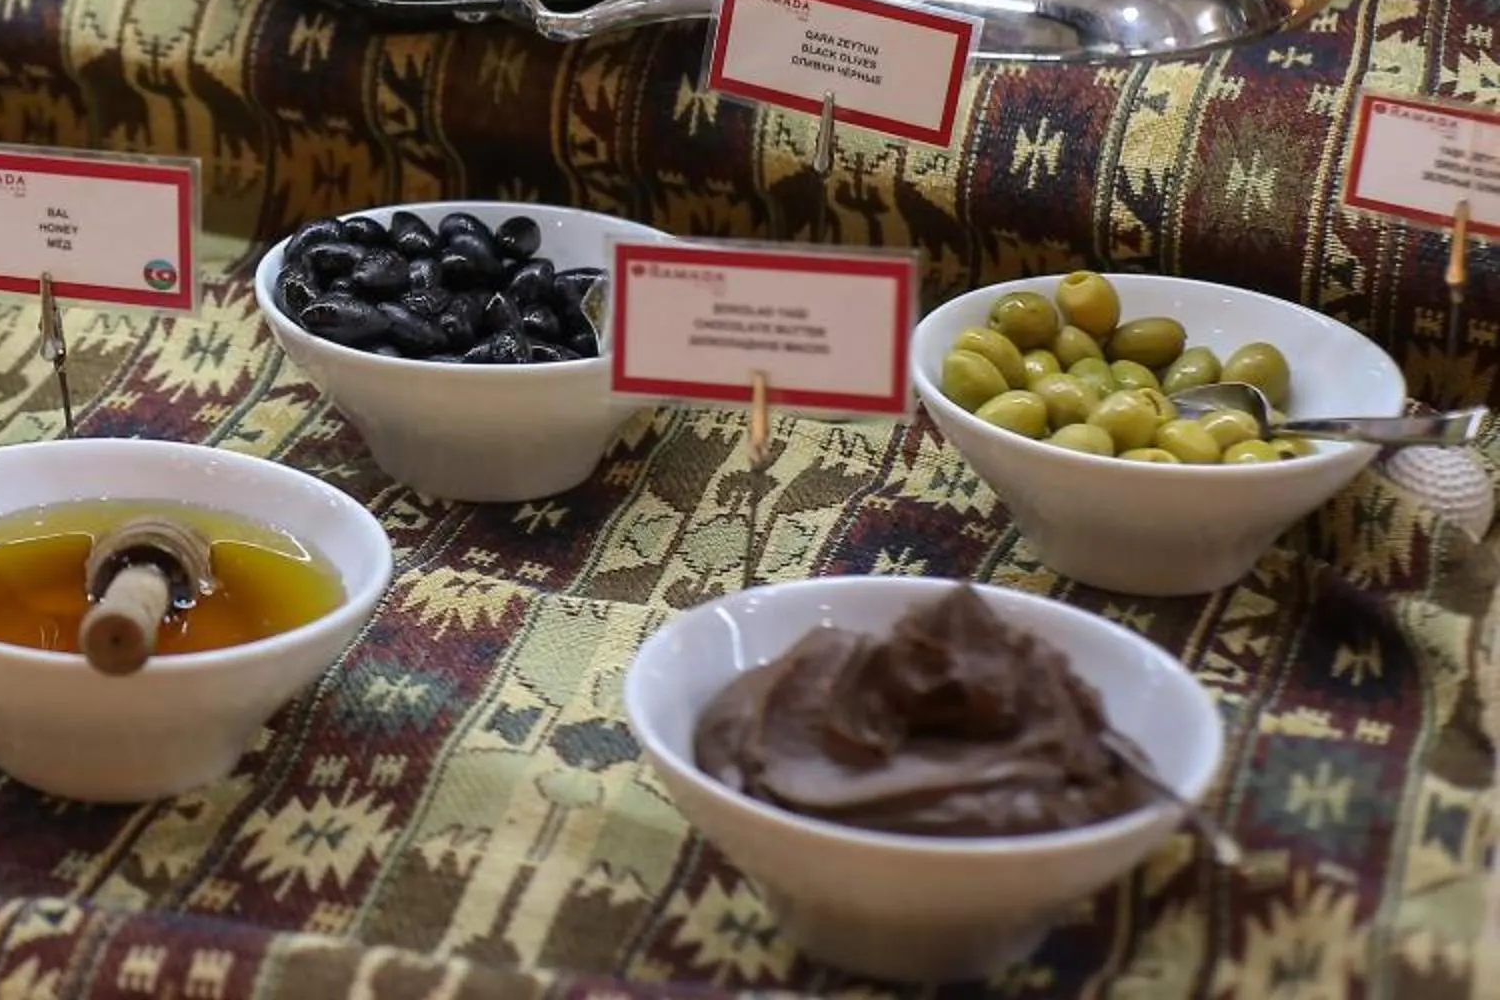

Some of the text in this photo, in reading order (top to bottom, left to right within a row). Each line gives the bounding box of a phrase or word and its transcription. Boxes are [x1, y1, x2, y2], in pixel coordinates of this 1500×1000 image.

[805, 29, 879, 56] QARA ZEYTUN
[801, 43, 877, 70] BLACK OLIVES
[47, 207, 68, 218] BAL
[39, 223, 78, 235] HONEY
